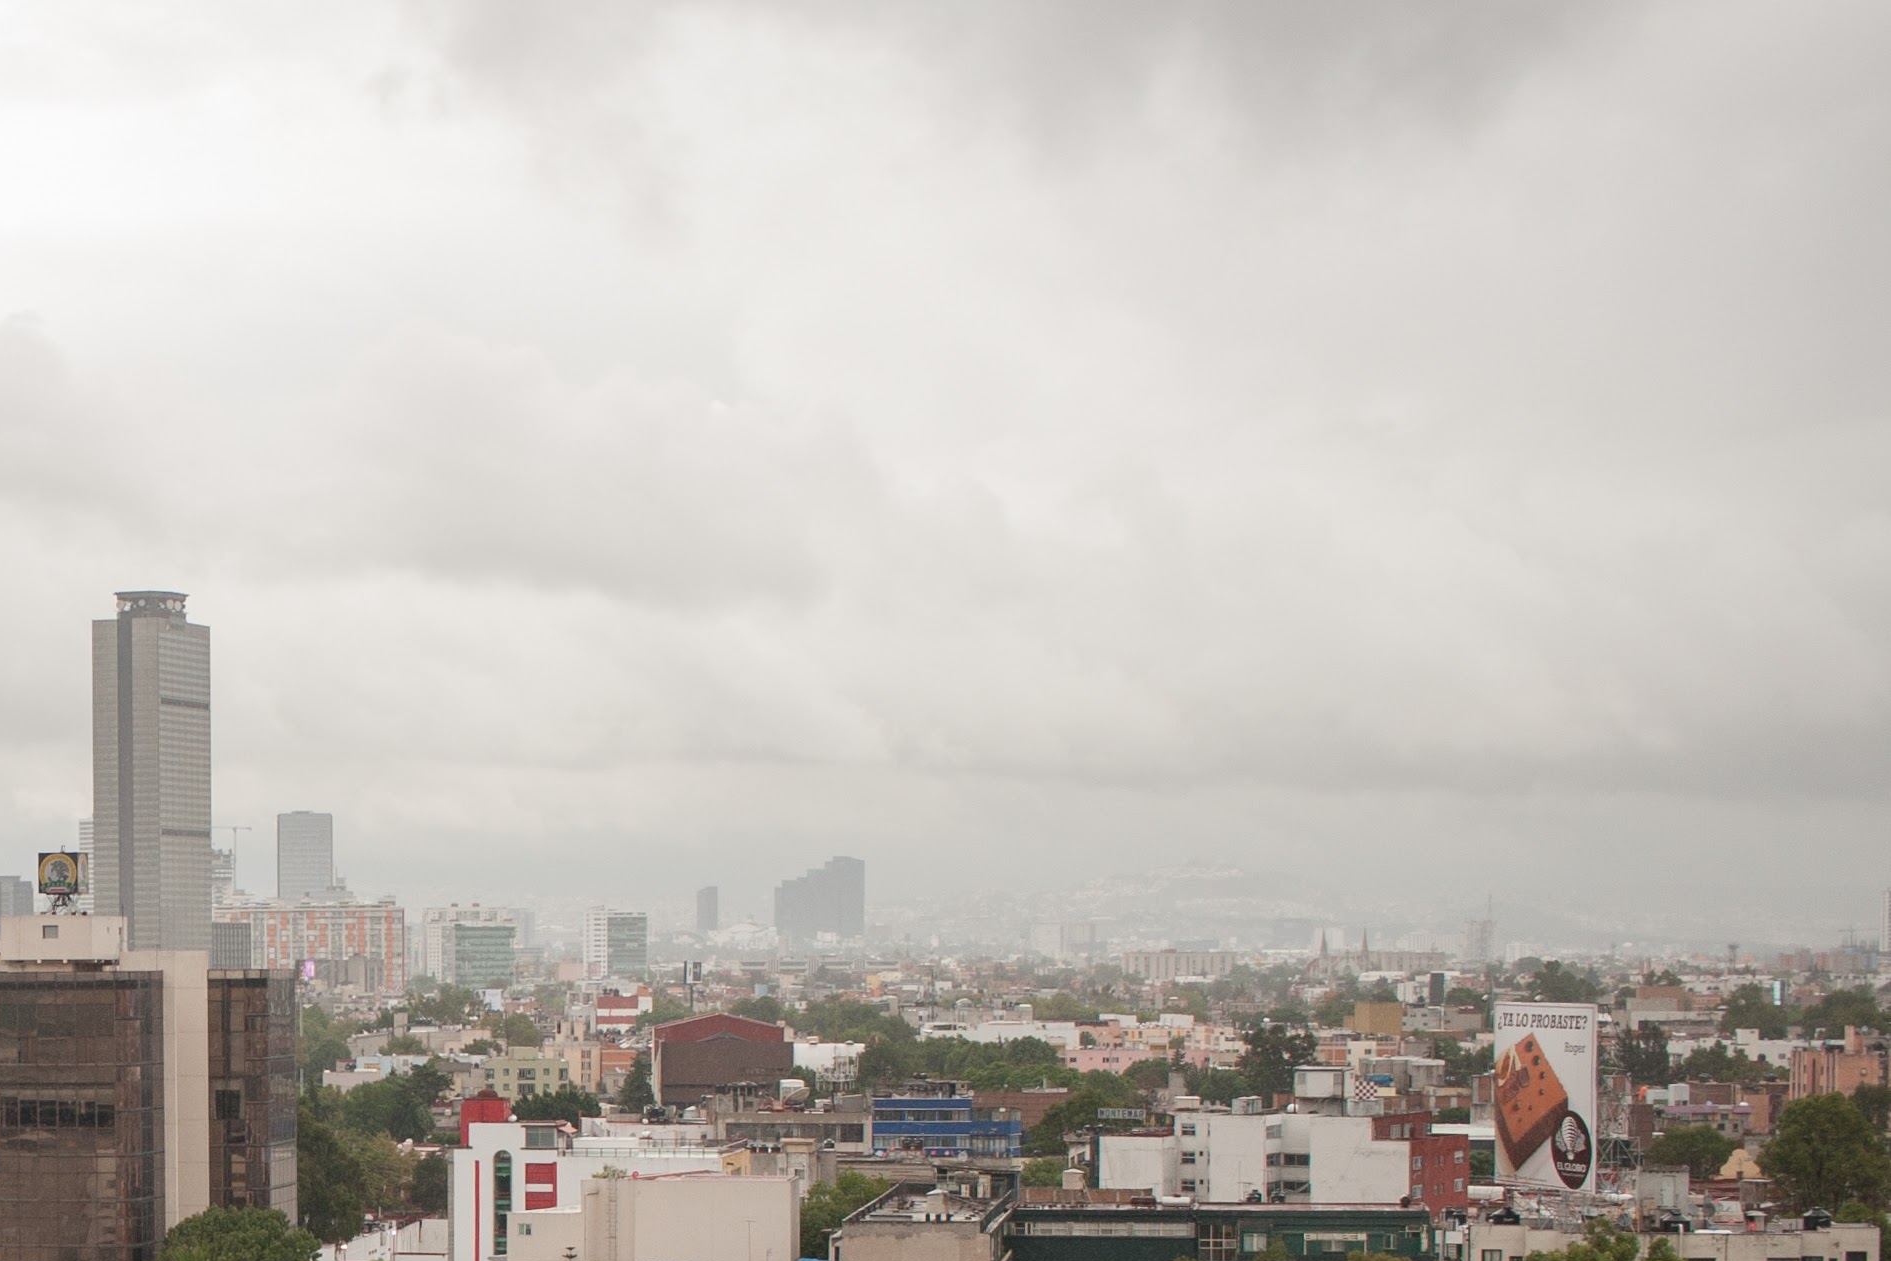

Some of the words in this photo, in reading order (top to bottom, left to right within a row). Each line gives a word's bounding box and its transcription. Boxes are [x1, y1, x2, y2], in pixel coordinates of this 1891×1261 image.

[1498, 1012, 1514, 1030] ¿YA
[1516, 1013, 1529, 1028] LO
[1530, 1014, 1588, 1030] PROBASTE?
[1099, 1109, 1144, 1118] MONTEMAR
